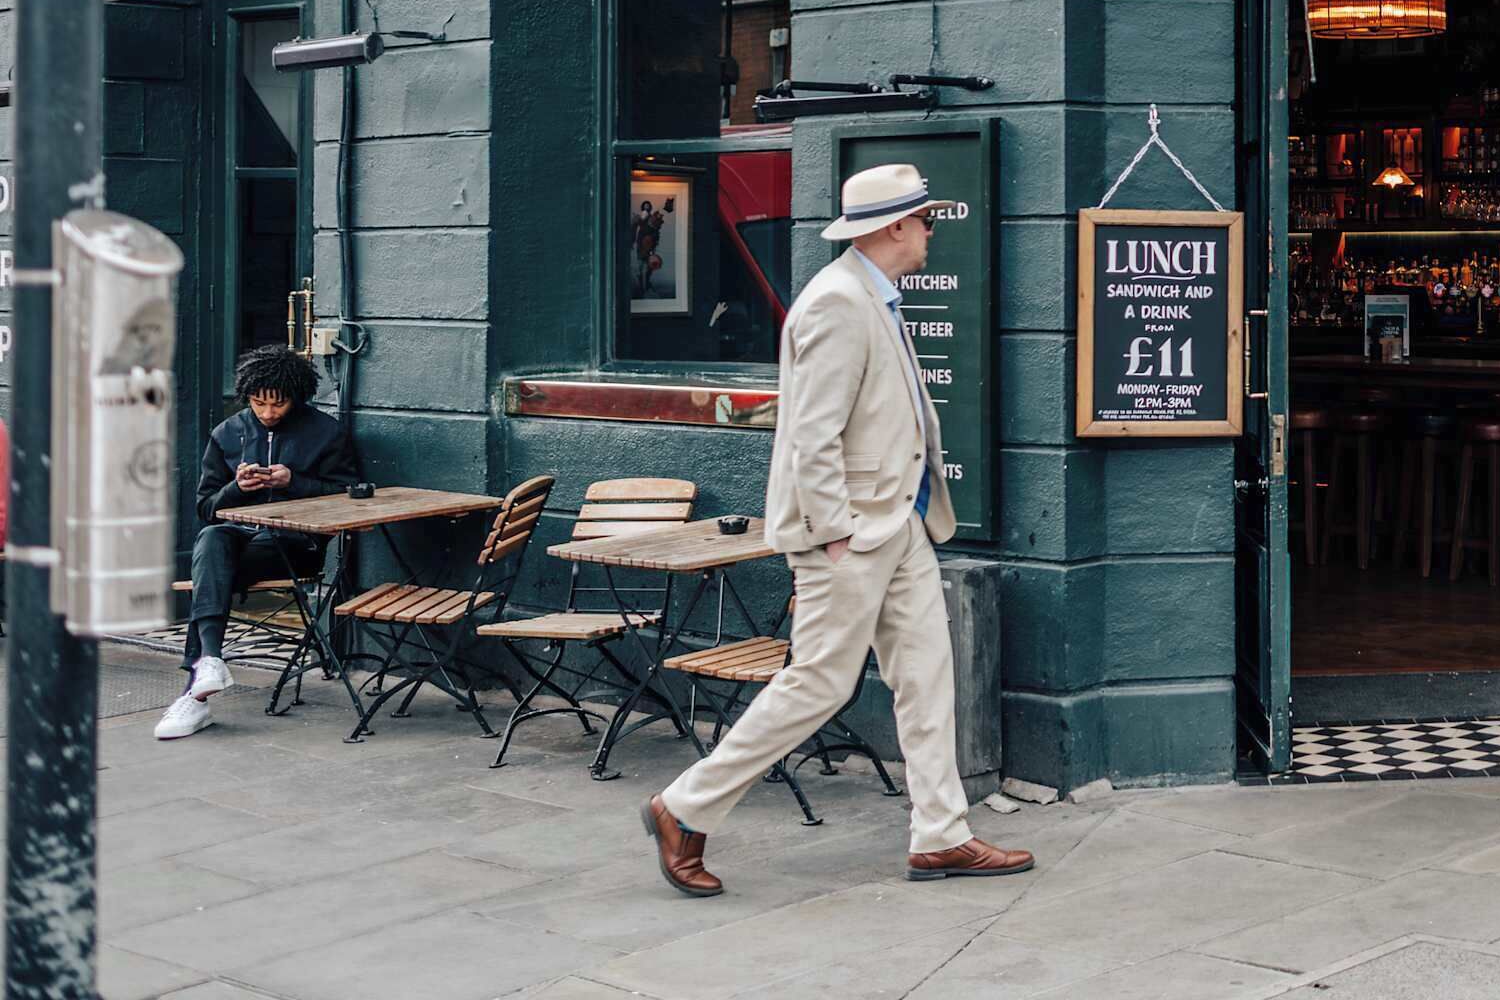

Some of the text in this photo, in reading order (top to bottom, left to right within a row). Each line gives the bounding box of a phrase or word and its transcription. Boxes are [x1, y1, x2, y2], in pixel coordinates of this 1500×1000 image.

[1105, 240, 1216, 275] LUNCH
[901, 275, 958, 290] KITCHEN
[1107, 284, 1213, 299] SANDWICH AND
[1124, 305, 1191, 319] A DRINK
[920, 322, 953, 337] BEER
[1144, 324, 1174, 332] FROM
[1123, 336, 1194, 377] £11
[921, 369, 953, 385] INES
